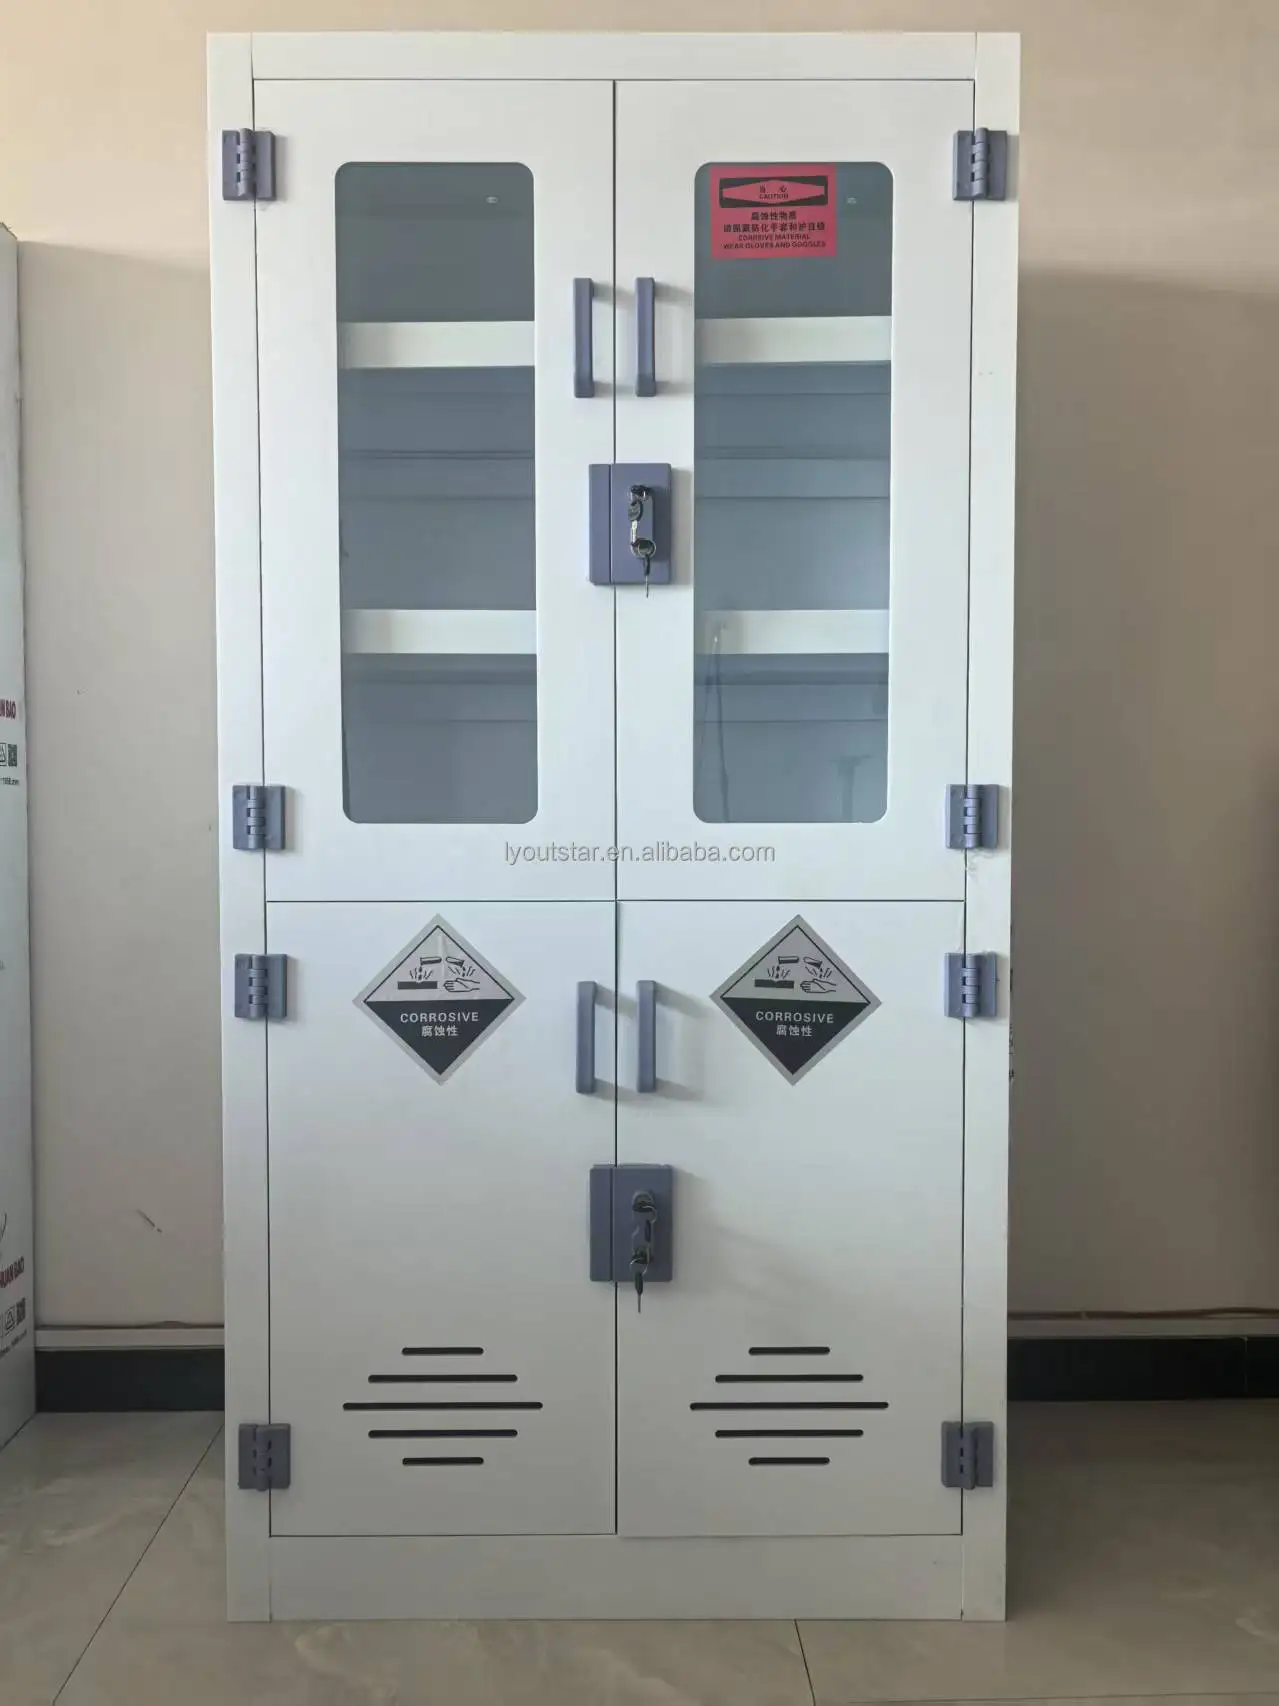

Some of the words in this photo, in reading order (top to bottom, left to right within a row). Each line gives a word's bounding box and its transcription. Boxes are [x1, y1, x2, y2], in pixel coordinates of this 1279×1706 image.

[751, 211, 797, 221] 腐蚀性物质
[775, 232, 811, 241] MATERIAL
[723, 242, 744, 250] WEAR
[745, 241, 774, 249] GLOVES
[775, 241, 791, 249] AND
[791, 240, 827, 249] GOGGLES
[400, 1012, 479, 1023] CORROSIVE
[755, 1011, 834, 1024] CORROSIVE
[421, 1025, 460, 1037] 腐蚀性
[776, 1025, 813, 1037] 腐蚀性
